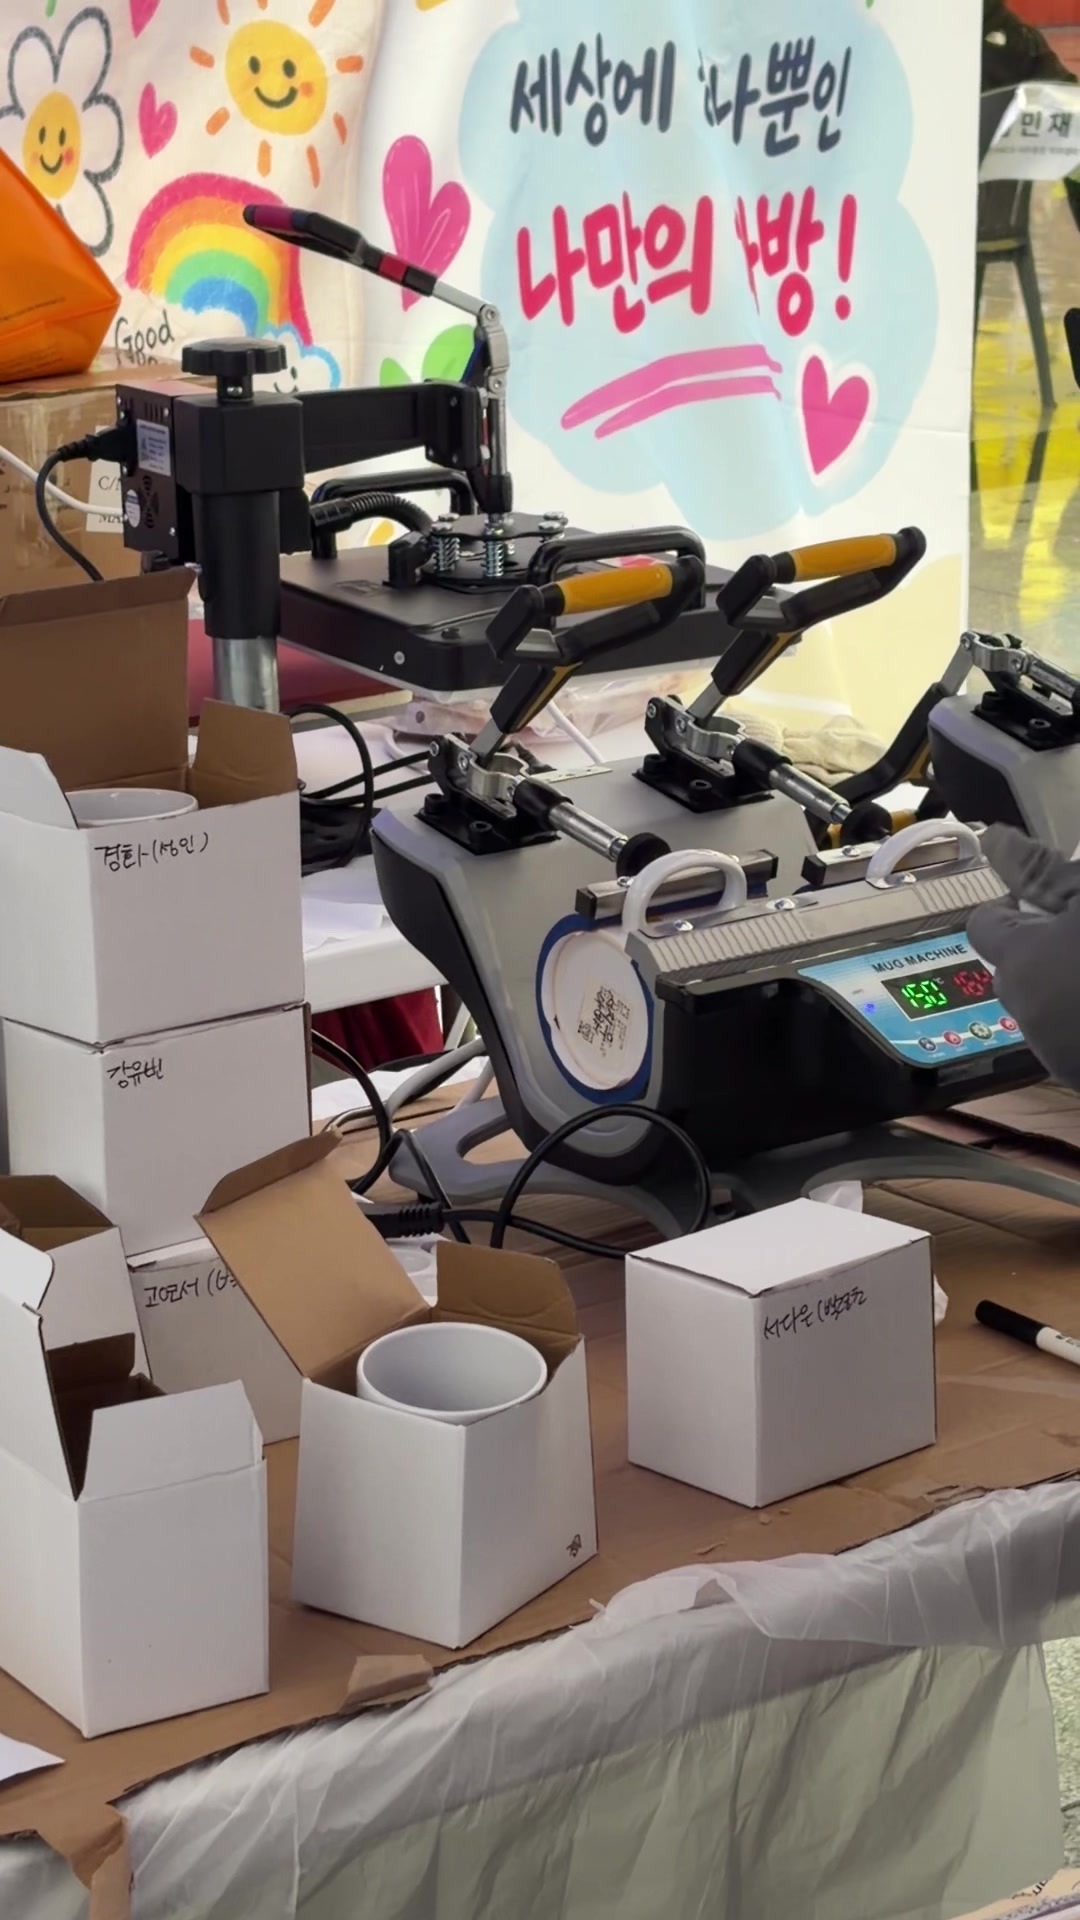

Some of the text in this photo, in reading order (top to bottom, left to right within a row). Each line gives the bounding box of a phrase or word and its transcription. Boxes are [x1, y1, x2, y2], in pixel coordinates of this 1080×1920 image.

[509, 33, 852, 158] 세상에 나뿐인
[1002, 111, 1073, 138] 민재
[516, 190, 714, 335] 나만의
[115, 308, 175, 352] Good
[871, 943, 968, 973] MUG MACHINE
[901, 980, 947, 1009] 150
